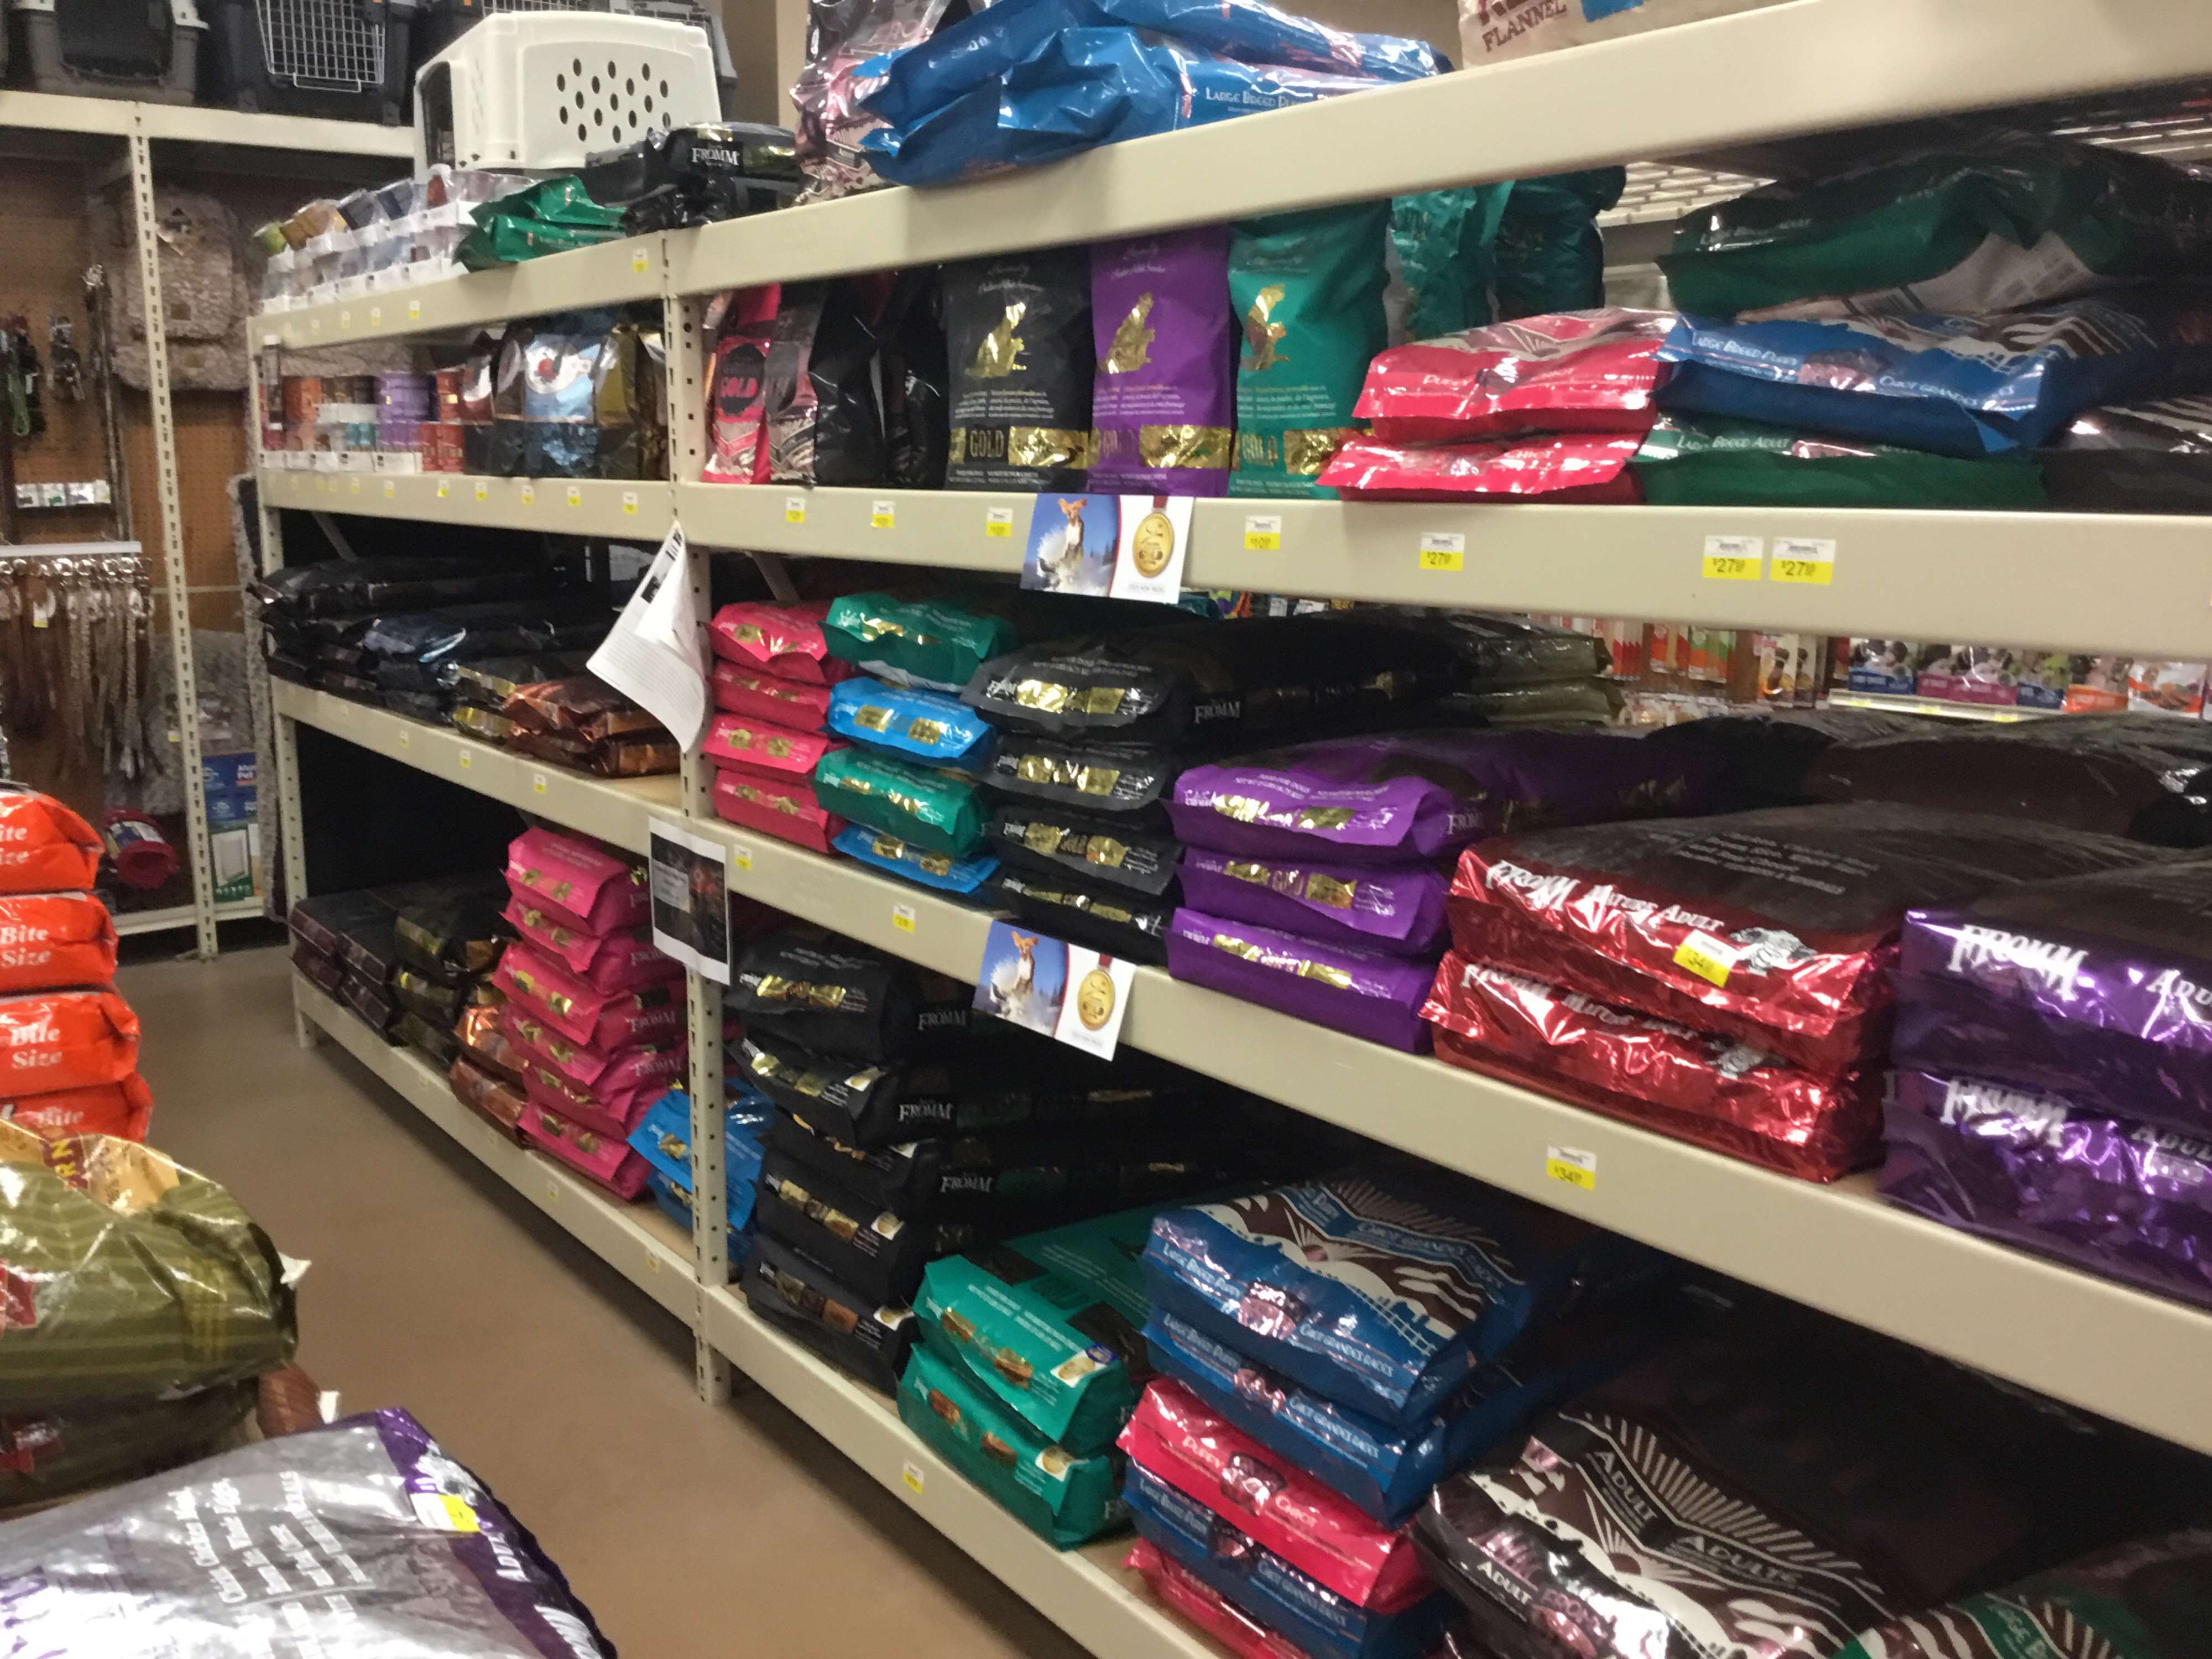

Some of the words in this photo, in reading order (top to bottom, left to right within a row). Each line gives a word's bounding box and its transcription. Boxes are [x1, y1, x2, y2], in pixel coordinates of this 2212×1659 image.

[1481, 0, 1567, 53] FLANNEL
[1206, 86, 1240, 103] LARGE
[691, 147, 740, 166] FROMM
[969, 430, 1004, 458] GOLD
[1659, 904, 1725, 931] ADULT
[2, 924, 49, 942] Bite
[2, 947, 51, 968] Size
[1947, 924, 2089, 1001] FROMM
[2146, 969, 2212, 1008] ADU
[9, 1024, 61, 1047] Bite
[11, 1050, 63, 1070] Size
[898, 1103, 955, 1122] FROMM
[940, 1176, 995, 1193] FROMM
[1182, 1435, 1224, 1469] PUPPY
[1275, 1493, 1318, 1528] CHIOT
[1593, 1450, 1658, 1522] ADULT
[1477, 1561, 1531, 1604] ADULT
